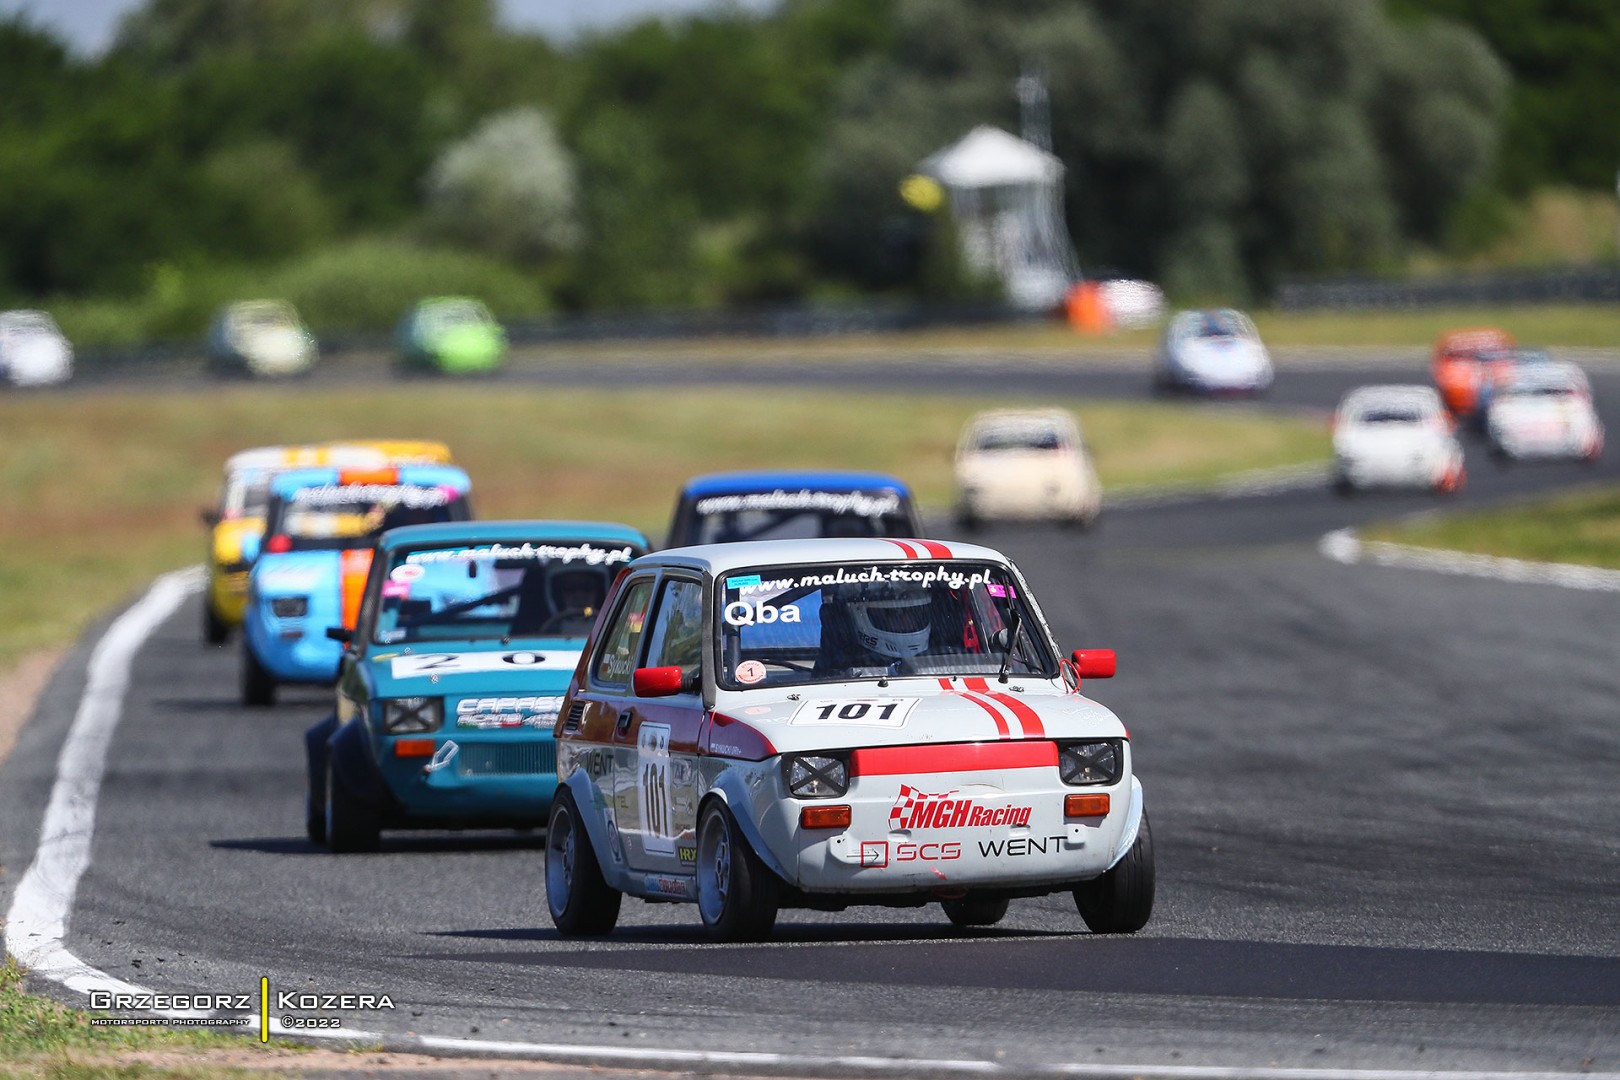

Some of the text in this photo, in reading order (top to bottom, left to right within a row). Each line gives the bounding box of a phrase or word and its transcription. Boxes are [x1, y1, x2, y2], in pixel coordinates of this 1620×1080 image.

[740, 565, 992, 594] www.maluch-trophy.pl
[724, 601, 801, 627] Qba
[816, 703, 899, 720] 101
[643, 763, 669, 839] 101
[908, 800, 1033, 828] MGH Racing
[897, 837, 1067, 861] SCS WENT
